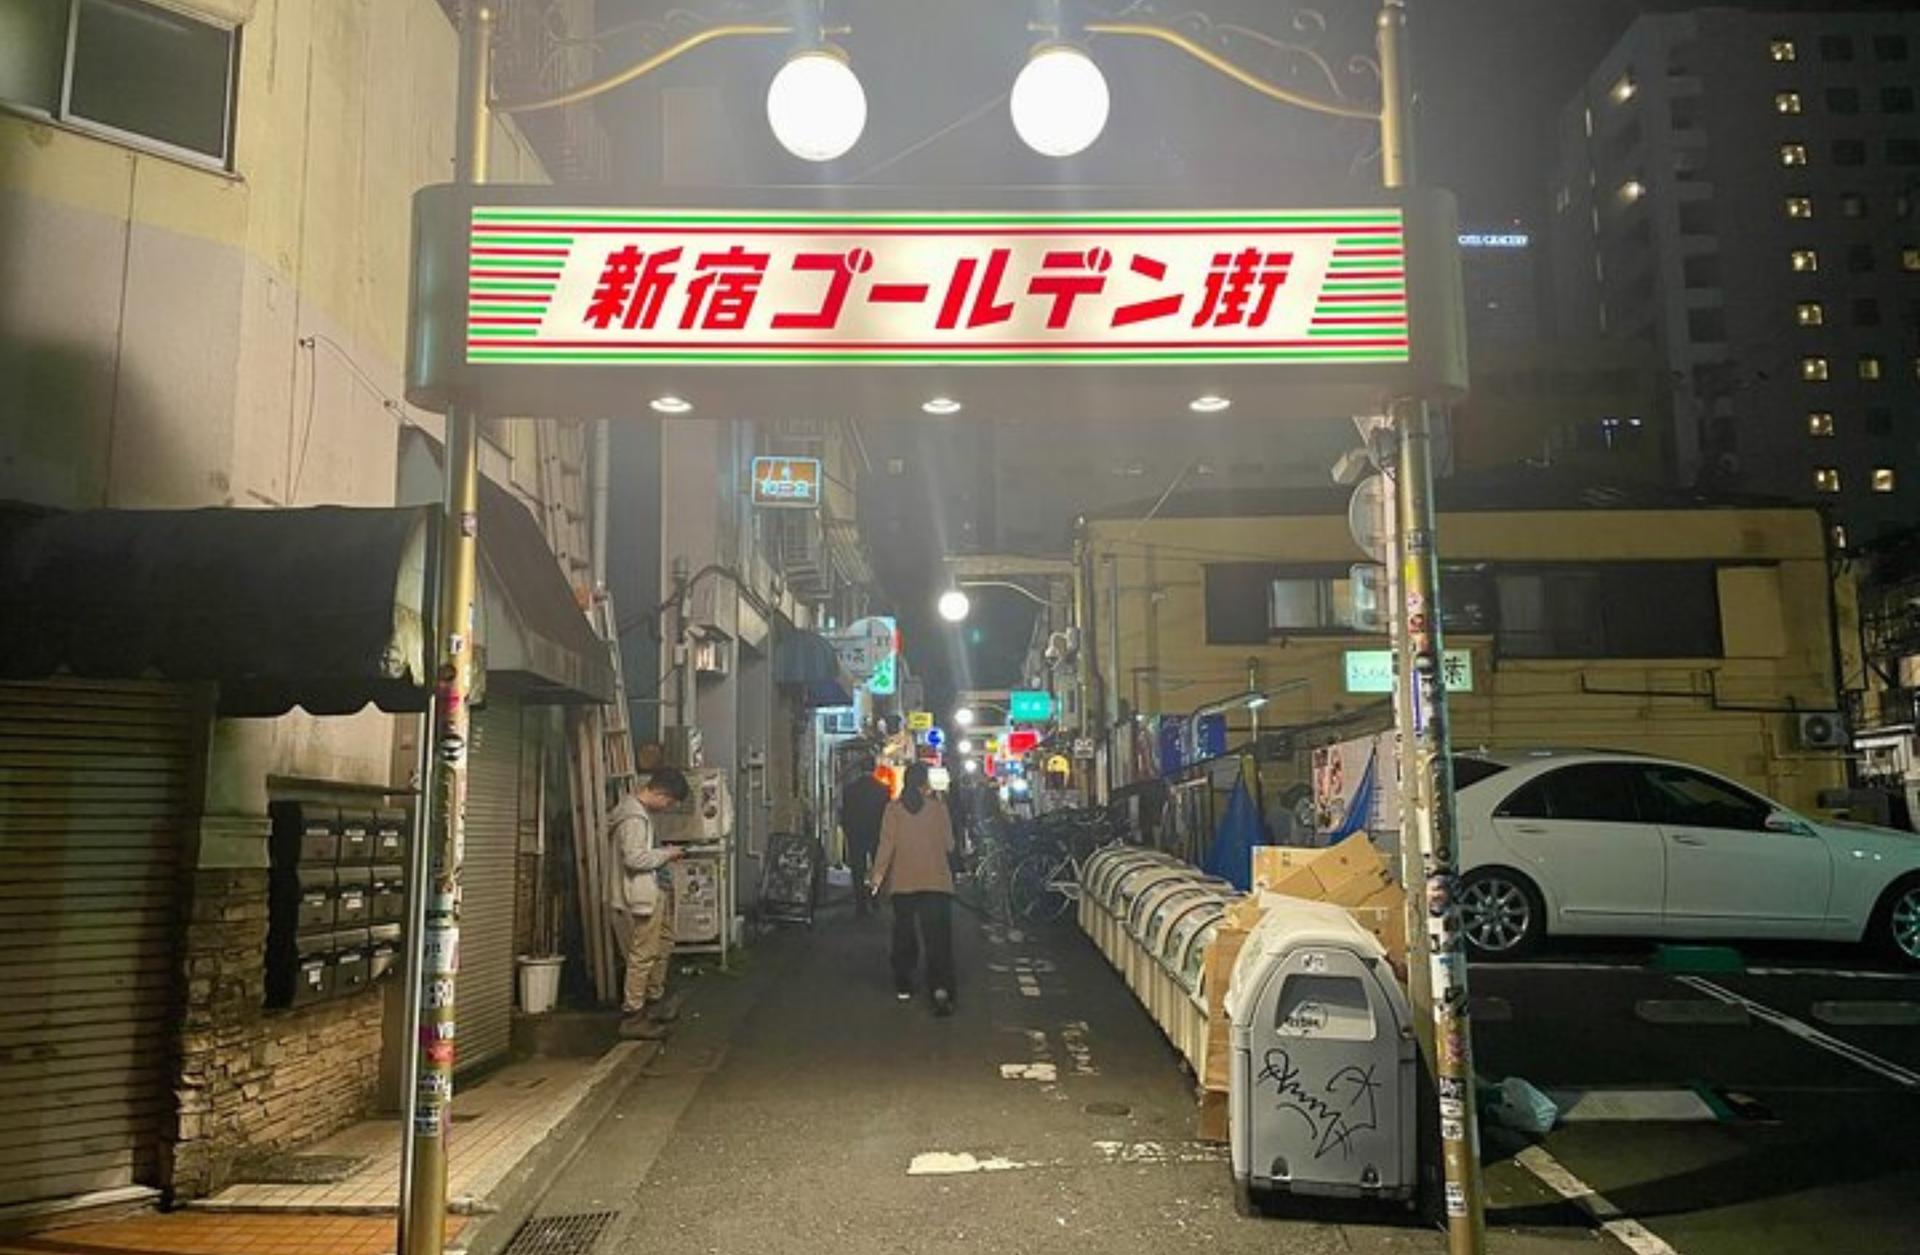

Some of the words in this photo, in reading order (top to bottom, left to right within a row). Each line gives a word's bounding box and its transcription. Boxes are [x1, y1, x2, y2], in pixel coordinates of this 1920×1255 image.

[583, 246, 1293, 329] 新宿ゴールデン街
